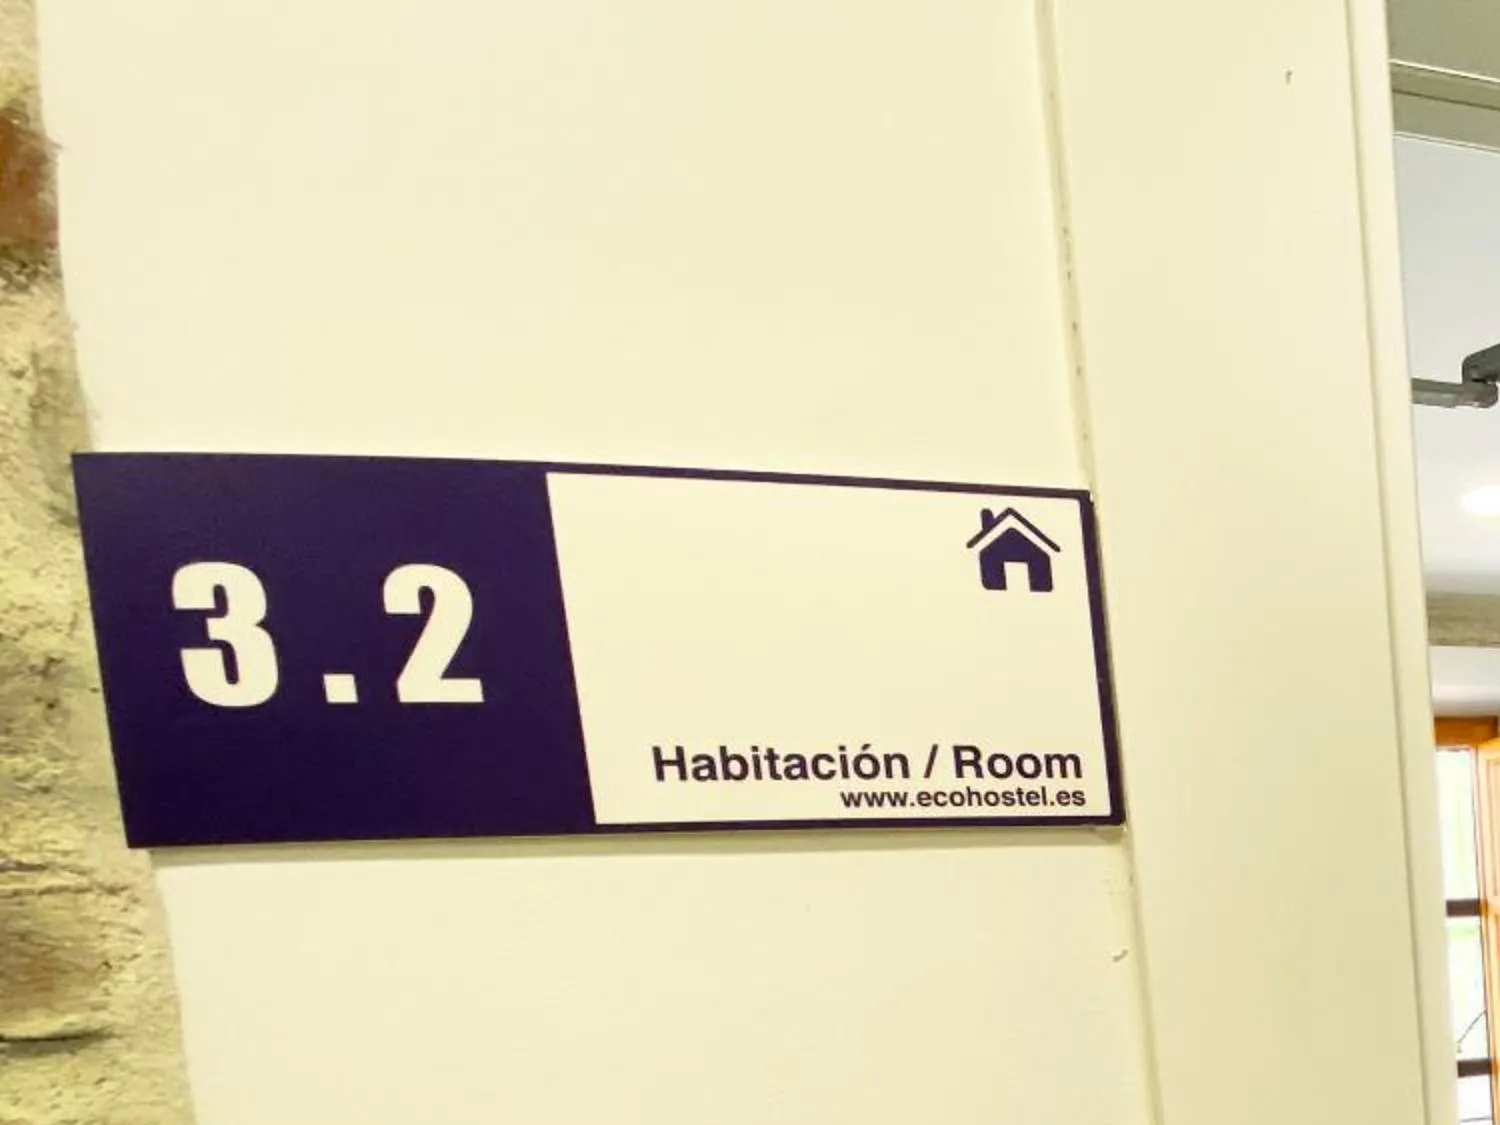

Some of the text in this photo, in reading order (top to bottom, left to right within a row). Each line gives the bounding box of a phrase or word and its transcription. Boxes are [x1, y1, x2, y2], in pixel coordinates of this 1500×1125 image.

[652, 743, 1083, 783] Habitación / Room
[840, 785, 1087, 808] www.ecohostel.es
